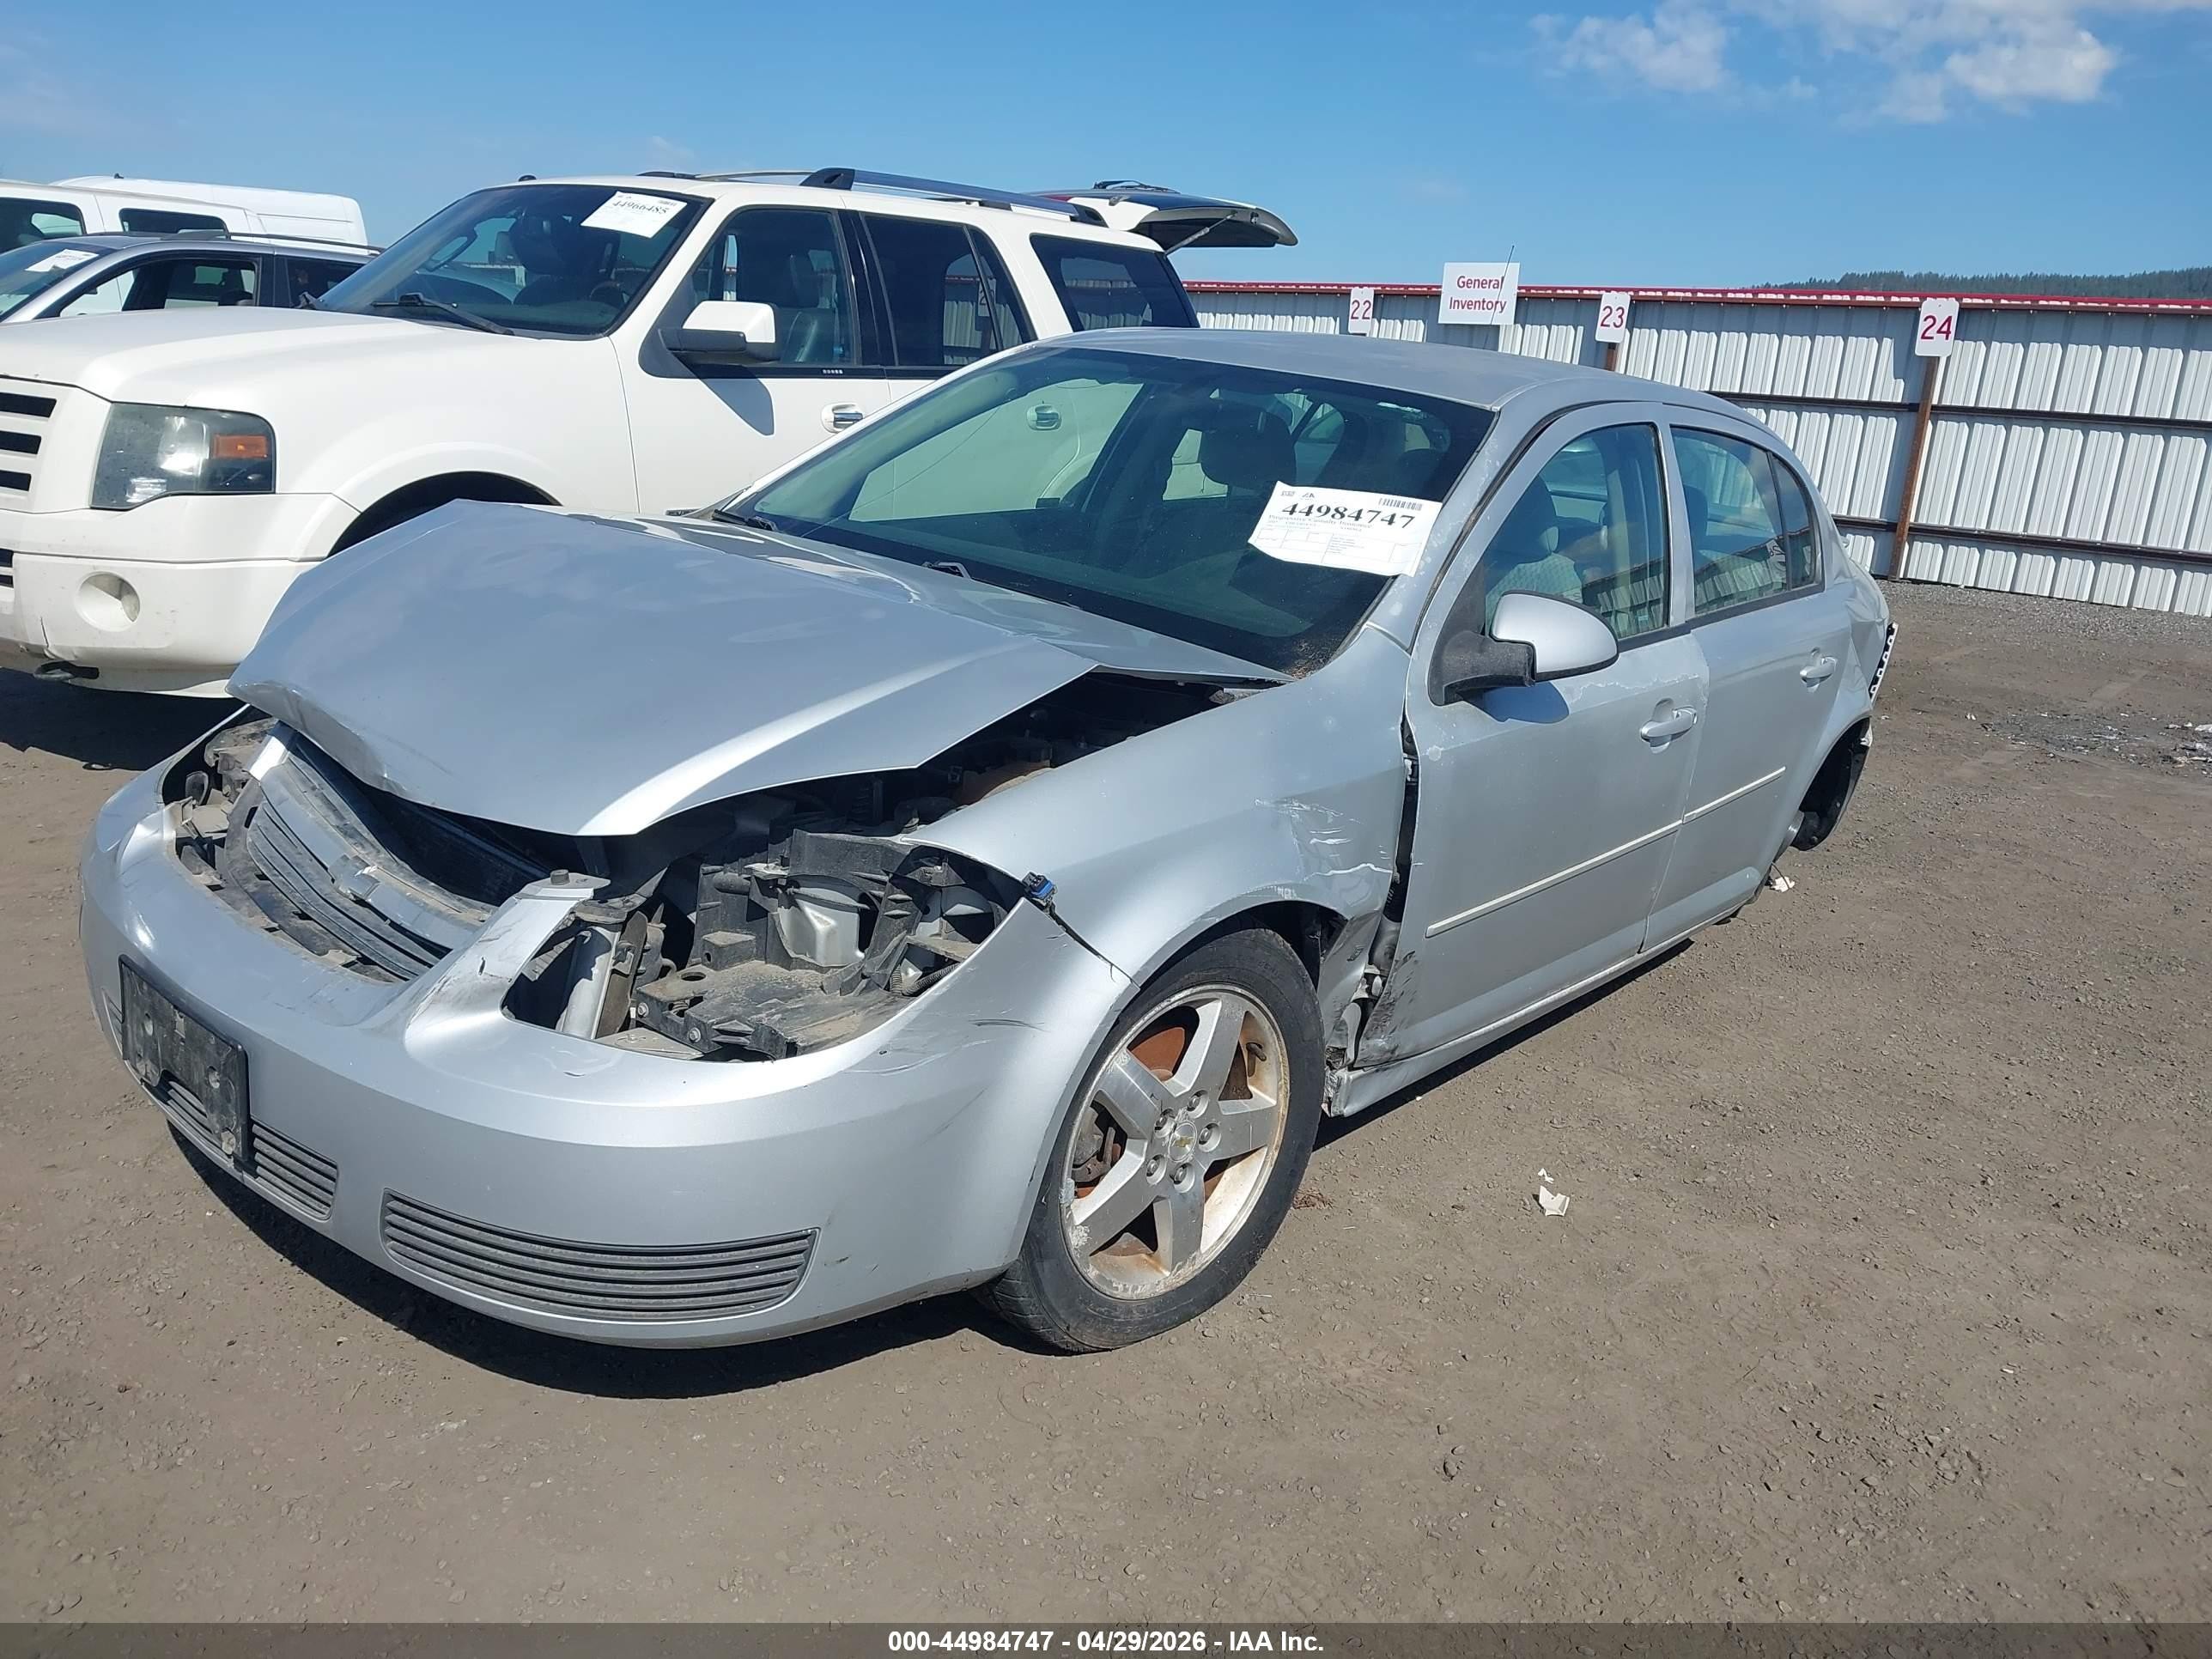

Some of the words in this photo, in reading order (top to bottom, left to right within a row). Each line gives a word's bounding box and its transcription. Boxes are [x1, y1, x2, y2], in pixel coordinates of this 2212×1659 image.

[1457, 276, 1504, 289] General
[1351, 300, 1371, 320] 22
[1449, 296, 1507, 313] Inventory
[1601, 306, 1626, 328] 23
[1920, 315, 1953, 341] 24
[1281, 502, 1416, 529] 44984747
